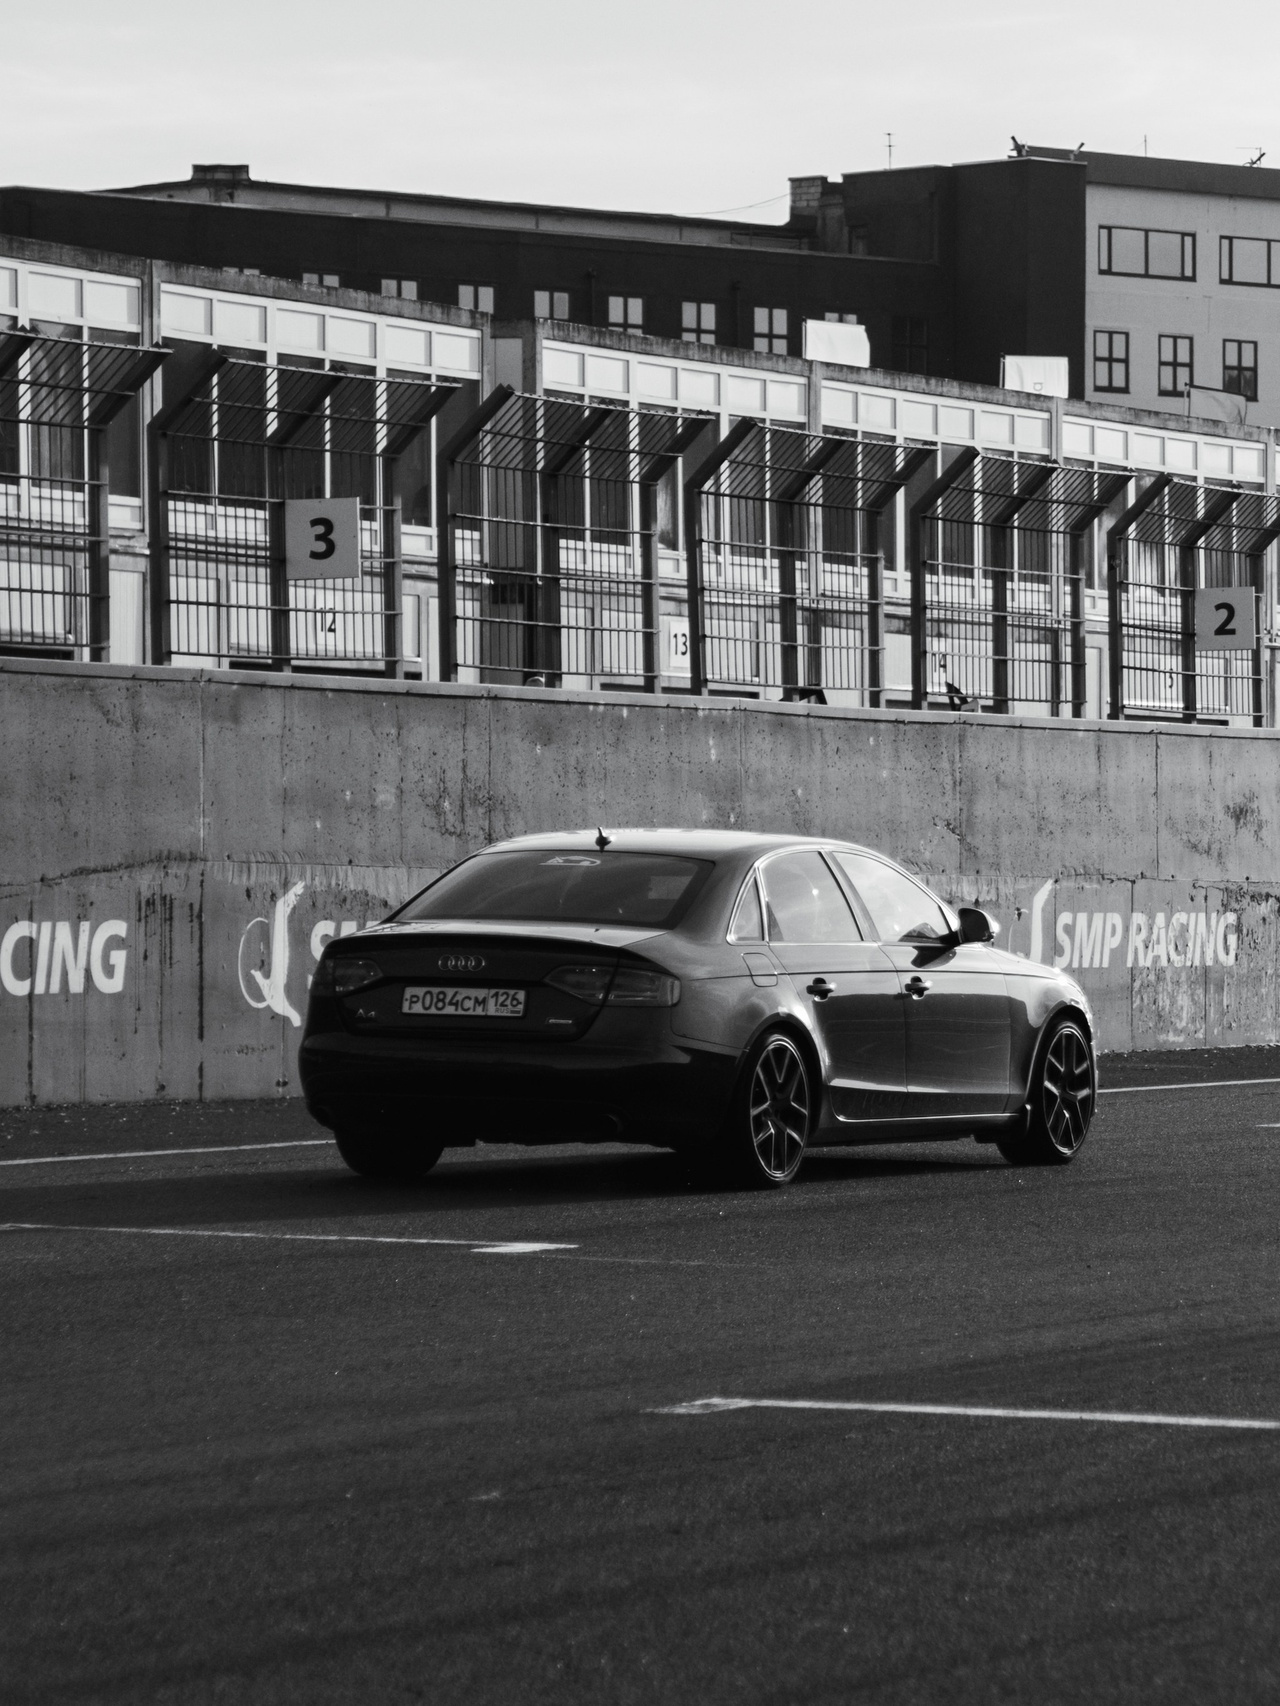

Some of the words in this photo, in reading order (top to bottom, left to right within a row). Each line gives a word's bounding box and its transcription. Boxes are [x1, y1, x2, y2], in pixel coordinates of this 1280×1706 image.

[308, 517, 336, 560] 3
[1214, 602, 1236, 635] 2
[673, 632, 688, 656] 13
[1054, 910, 1124, 969] SMP
[1126, 911, 1238, 968] RACING
[490, 991, 520, 1007] 126
[355, 1008, 376, 1019] A4
